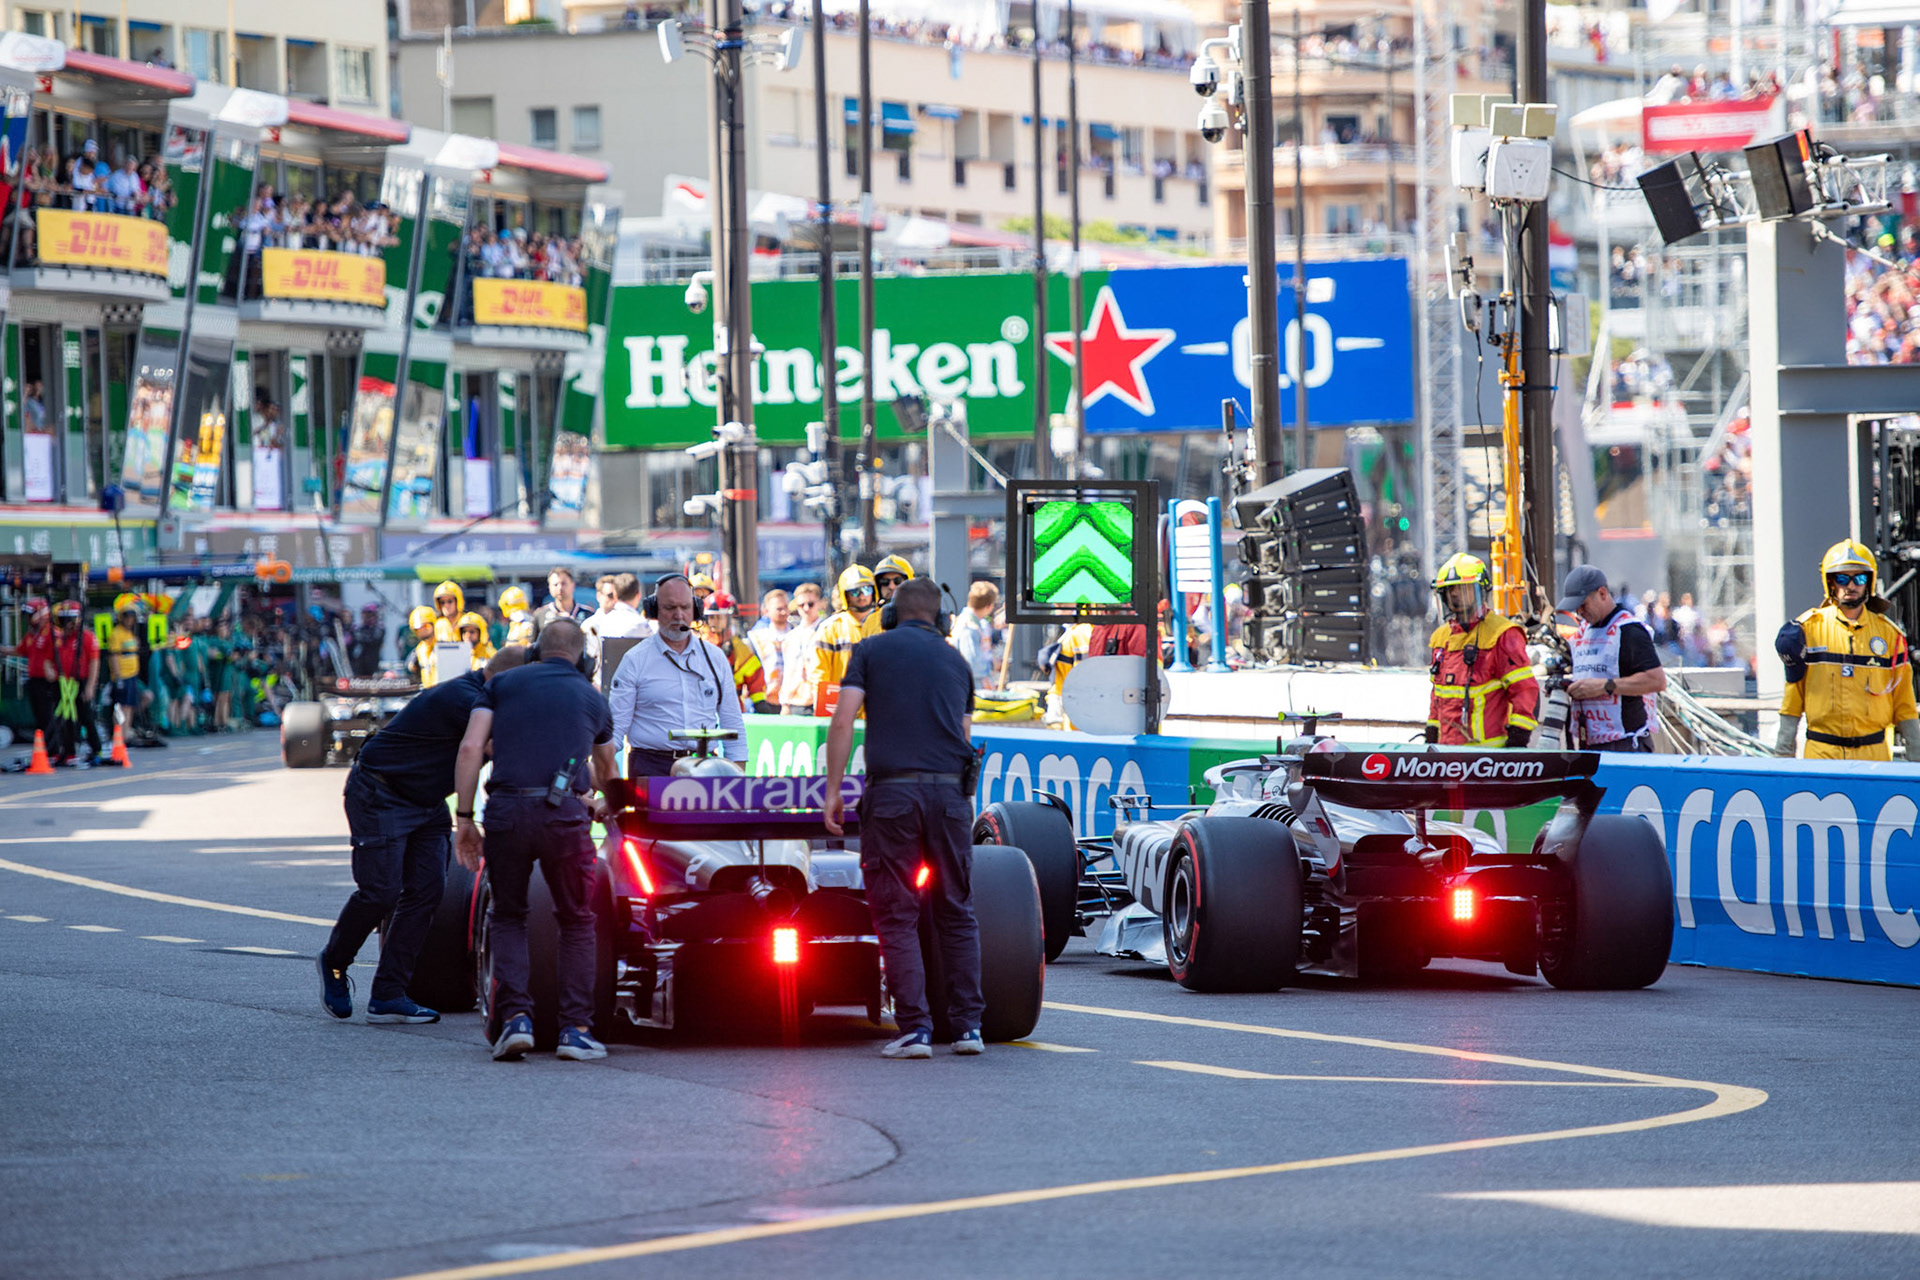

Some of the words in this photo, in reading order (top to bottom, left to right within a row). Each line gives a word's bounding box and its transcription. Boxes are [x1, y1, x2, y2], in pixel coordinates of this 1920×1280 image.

[69, 219, 122, 258] DHL
[292, 258, 341, 290] DHL
[501, 288, 545, 317] DHL
[1394, 756, 1545, 782] MoneyGram
[712, 777, 863, 811] krake
[973, 752, 1149, 872] ramco
[684, 853, 710, 886] 2
[1621, 784, 1920, 949] ramc
